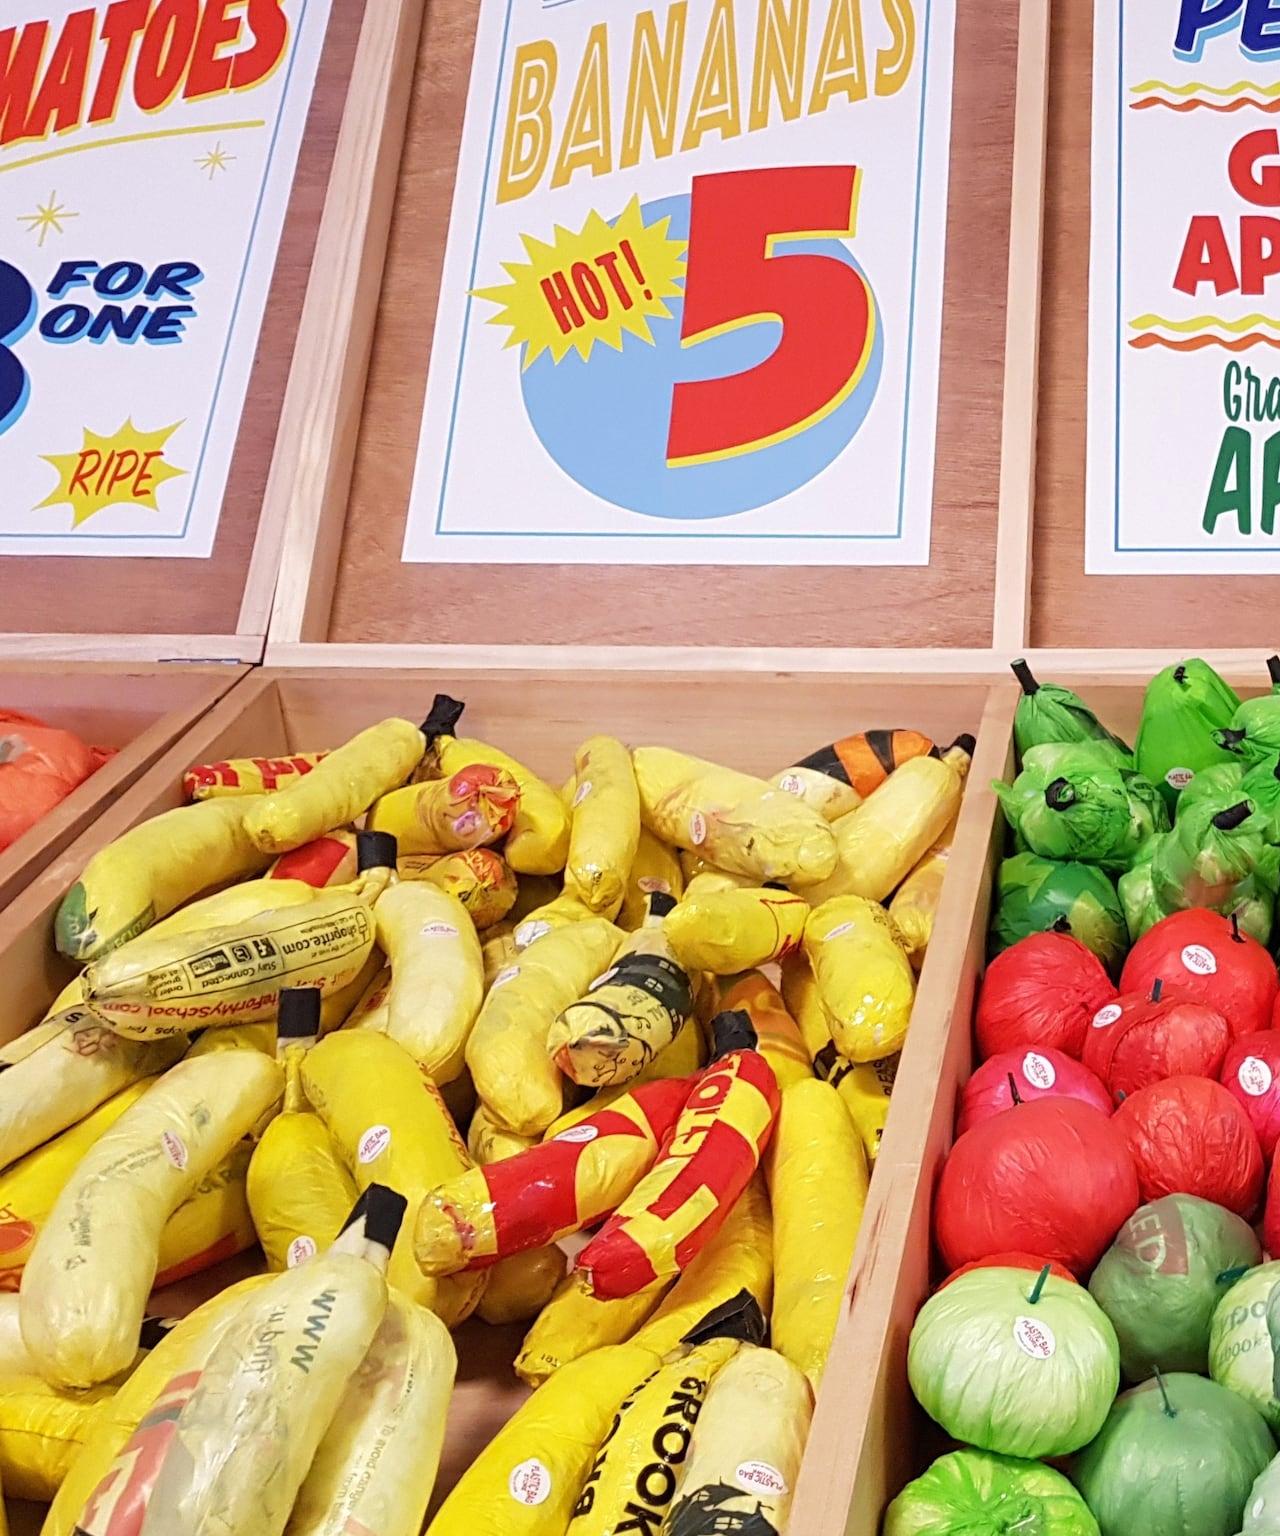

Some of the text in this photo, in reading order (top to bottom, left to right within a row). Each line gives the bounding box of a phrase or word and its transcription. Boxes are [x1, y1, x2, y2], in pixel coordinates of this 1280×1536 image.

[496, 0, 916, 205] BANANAS
[46, 261, 205, 300] FOR
[540, 239, 653, 335] HOT!
[39, 304, 198, 344] ONE
[666, 165, 876, 468] 5
[69, 449, 164, 497] RIPE
[282, 922, 358, 955] shoprite.com
[201, 966, 256, 988] Connected
[1021, 1319, 1051, 1356] PLASTIC BAG
[738, 1469, 784, 1491] PLASTIC BAG
